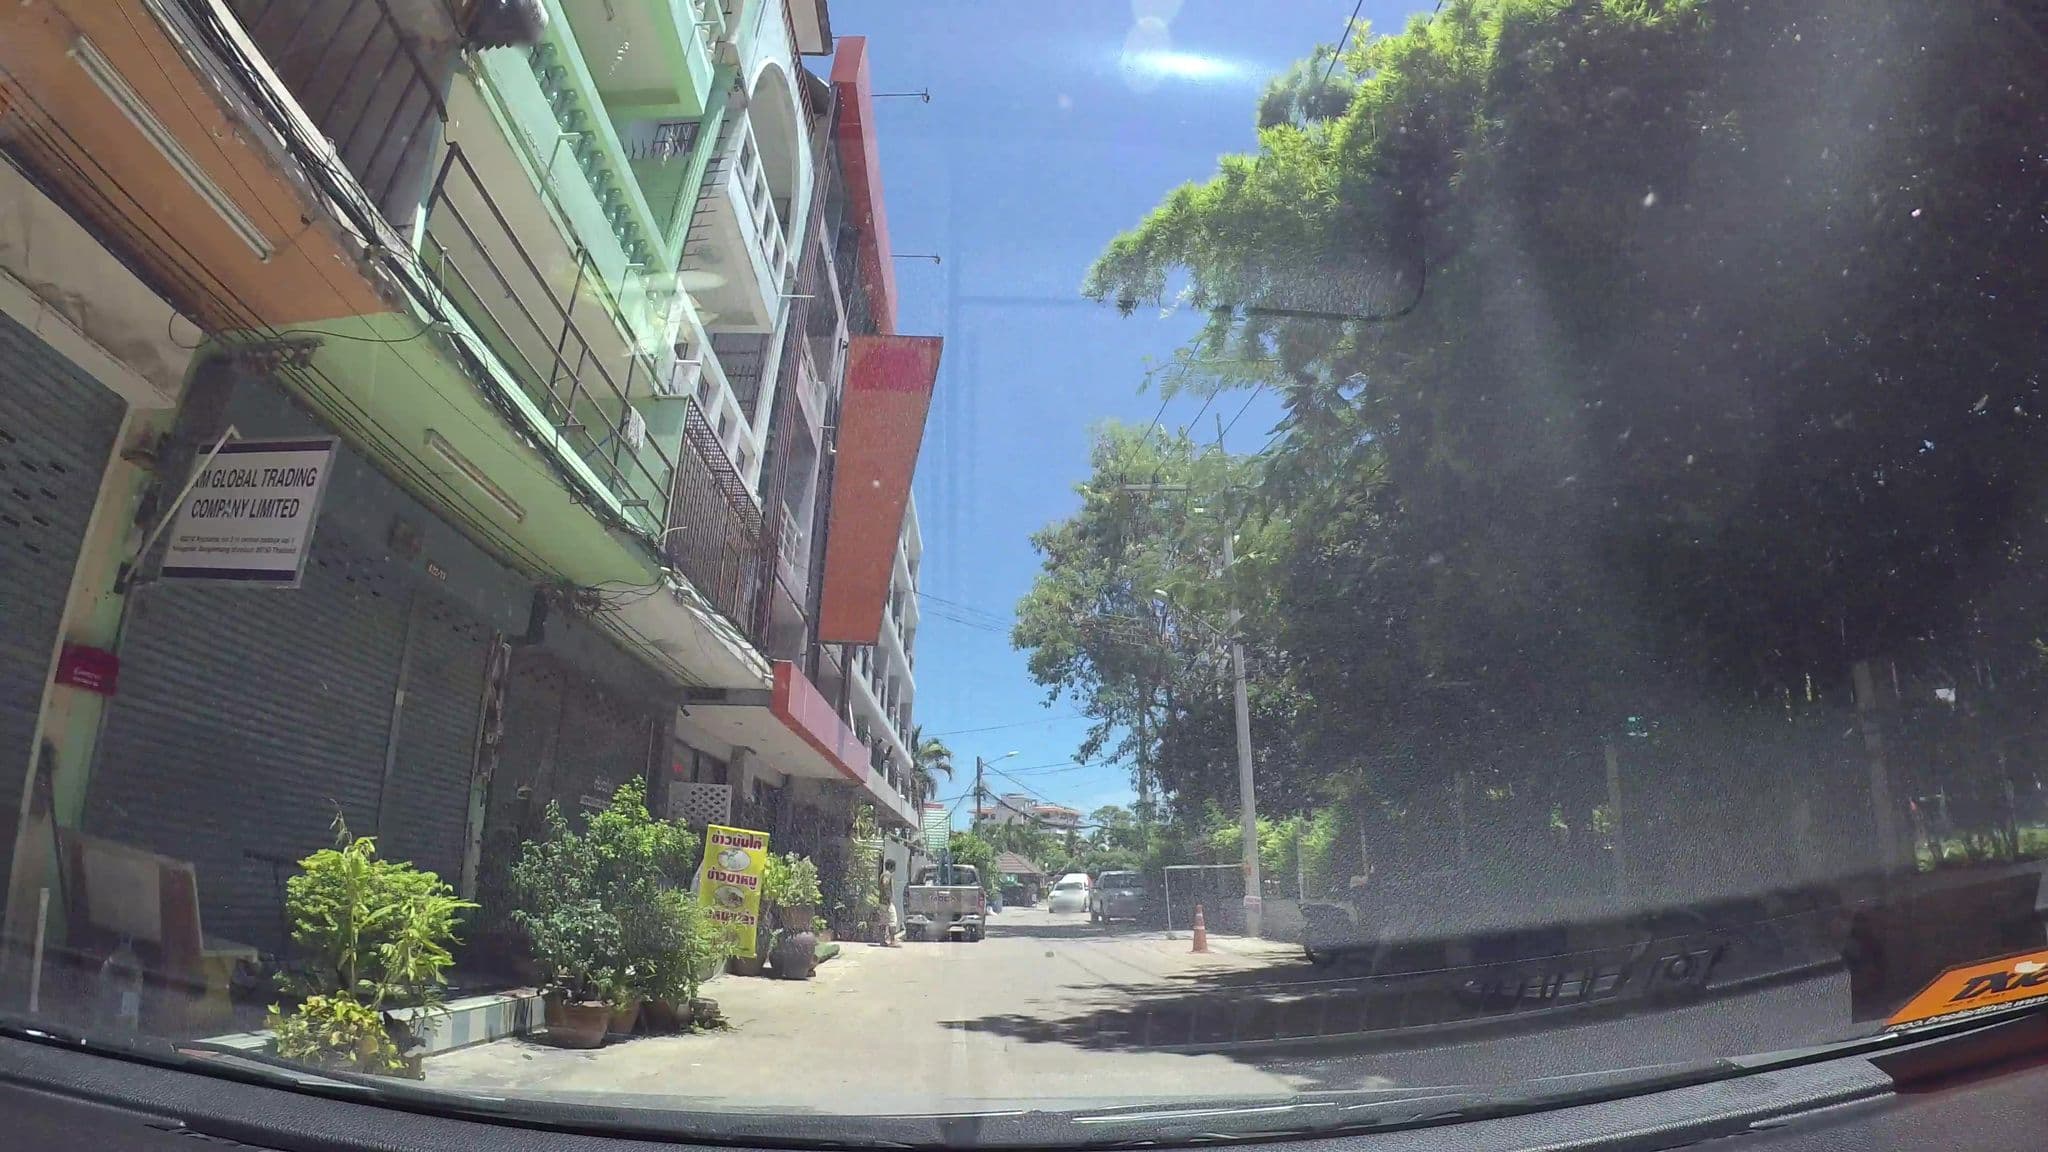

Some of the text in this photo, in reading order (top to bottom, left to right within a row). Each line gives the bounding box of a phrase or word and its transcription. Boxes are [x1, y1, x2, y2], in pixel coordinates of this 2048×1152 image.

[212, 469, 257, 488] GLOBAL
[260, 467, 318, 487] TRADING
[191, 498, 300, 518] COMPANY LIMITED
